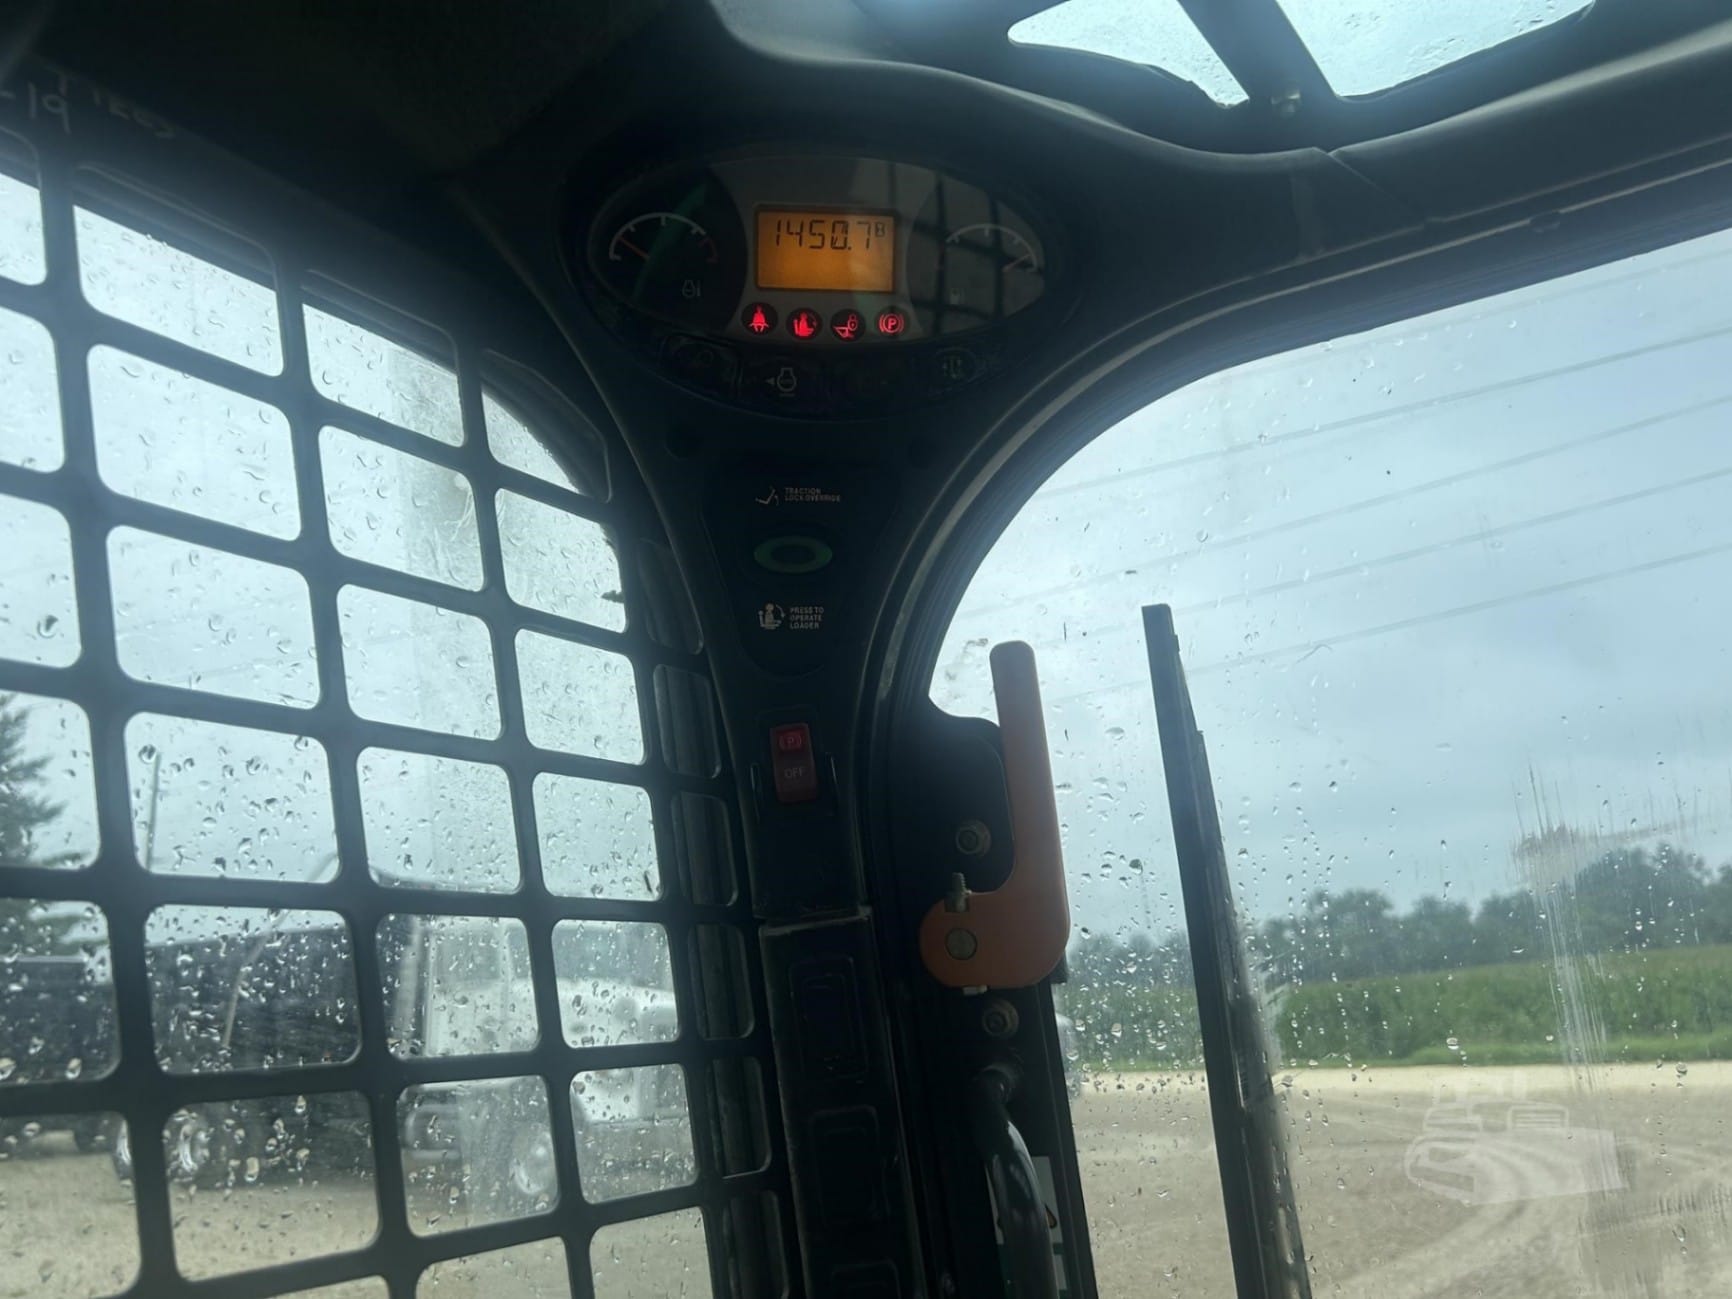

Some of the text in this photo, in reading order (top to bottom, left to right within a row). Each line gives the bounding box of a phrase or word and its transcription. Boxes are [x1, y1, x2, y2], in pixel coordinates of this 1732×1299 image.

[775, 219, 872, 251] 1450.7
[784, 494, 805, 502] LOCK
[789, 606, 825, 614] PRESS TO
[789, 614, 823, 622] OPERATE
[789, 622, 820, 630] LOADER
